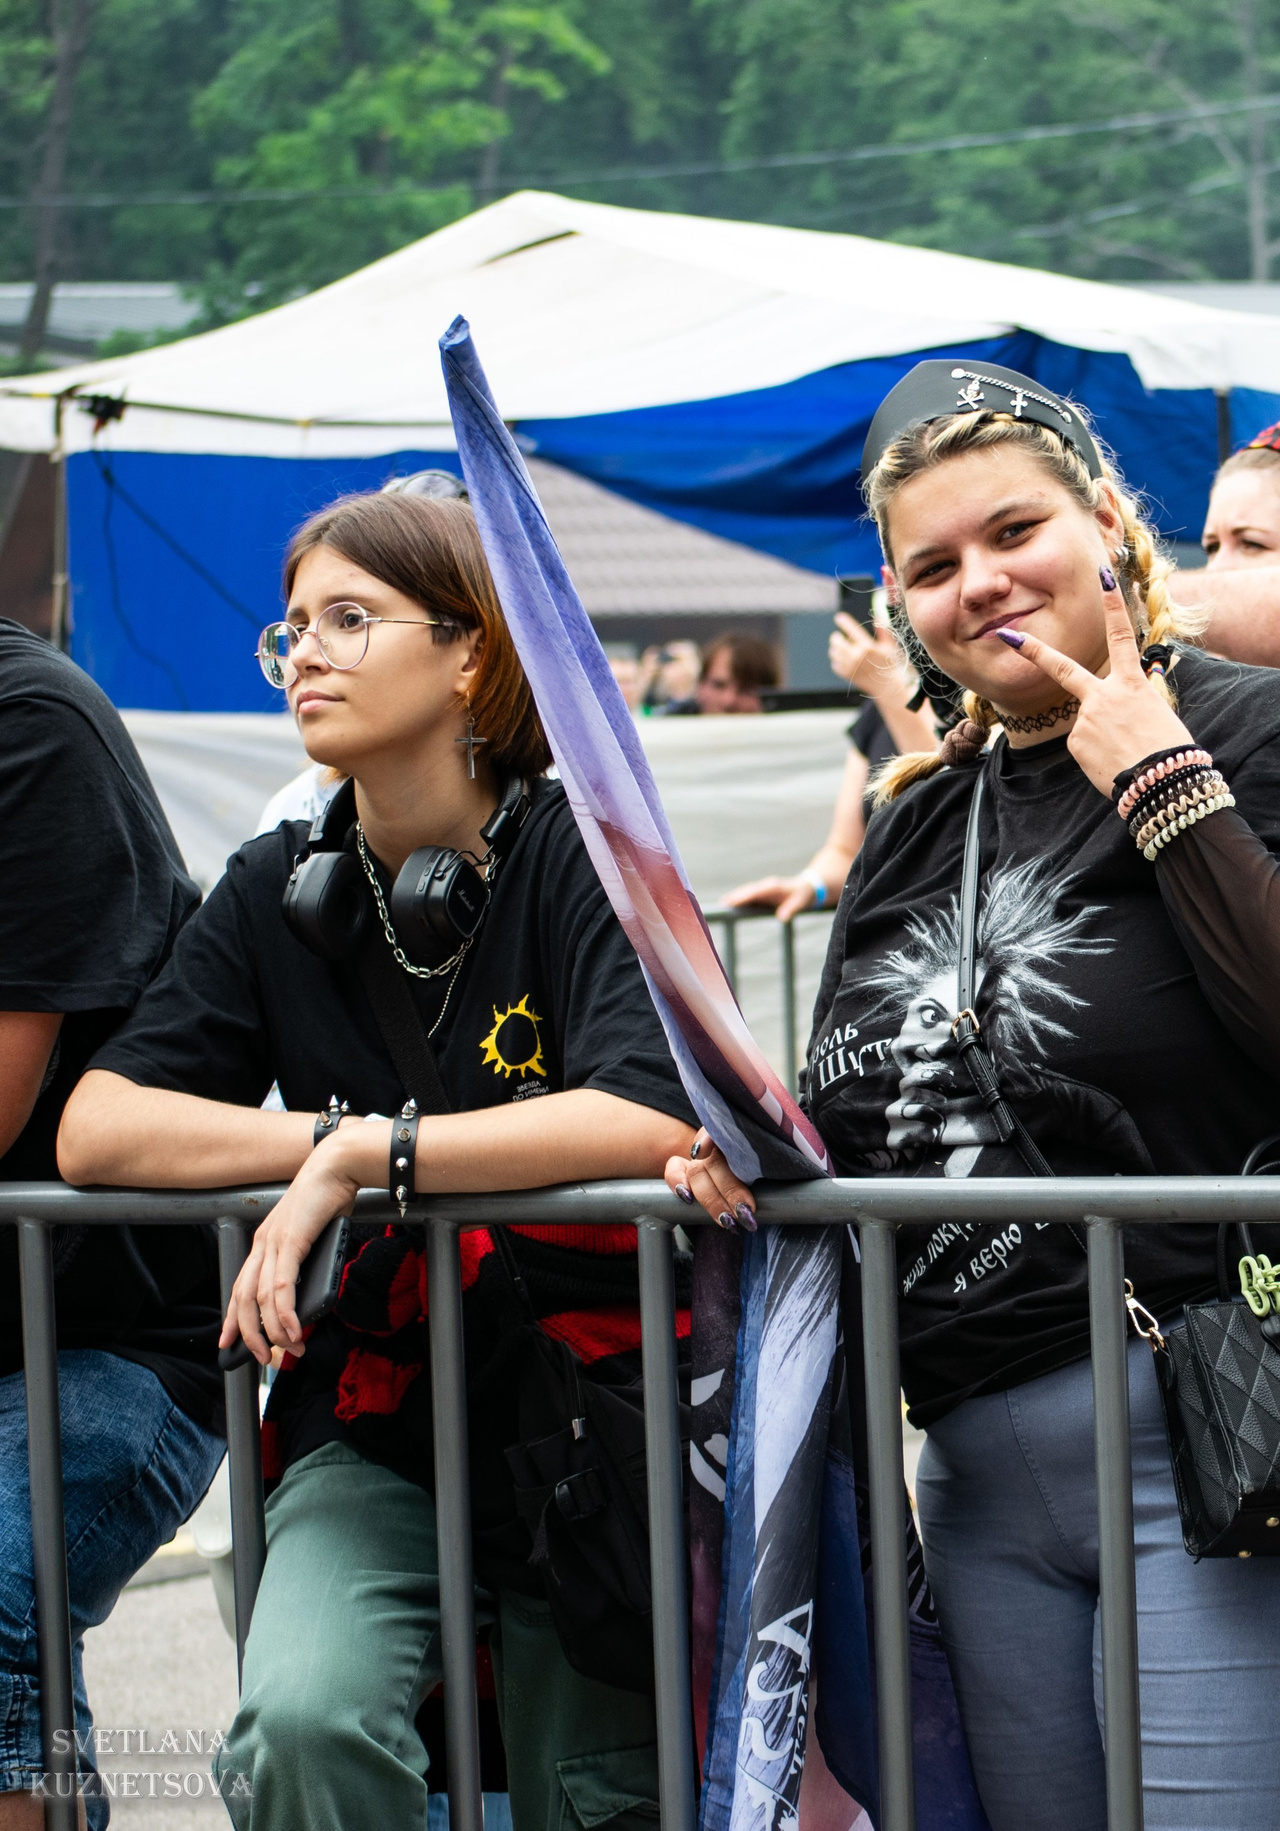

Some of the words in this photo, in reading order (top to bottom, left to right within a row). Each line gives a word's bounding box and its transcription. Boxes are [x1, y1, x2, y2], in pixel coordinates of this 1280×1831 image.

[516, 1080, 541, 1093] ЗВЕЗДА
[512, 1093, 524, 1102] ПО
[524, 1086, 550, 1098] ИМЕНИ
